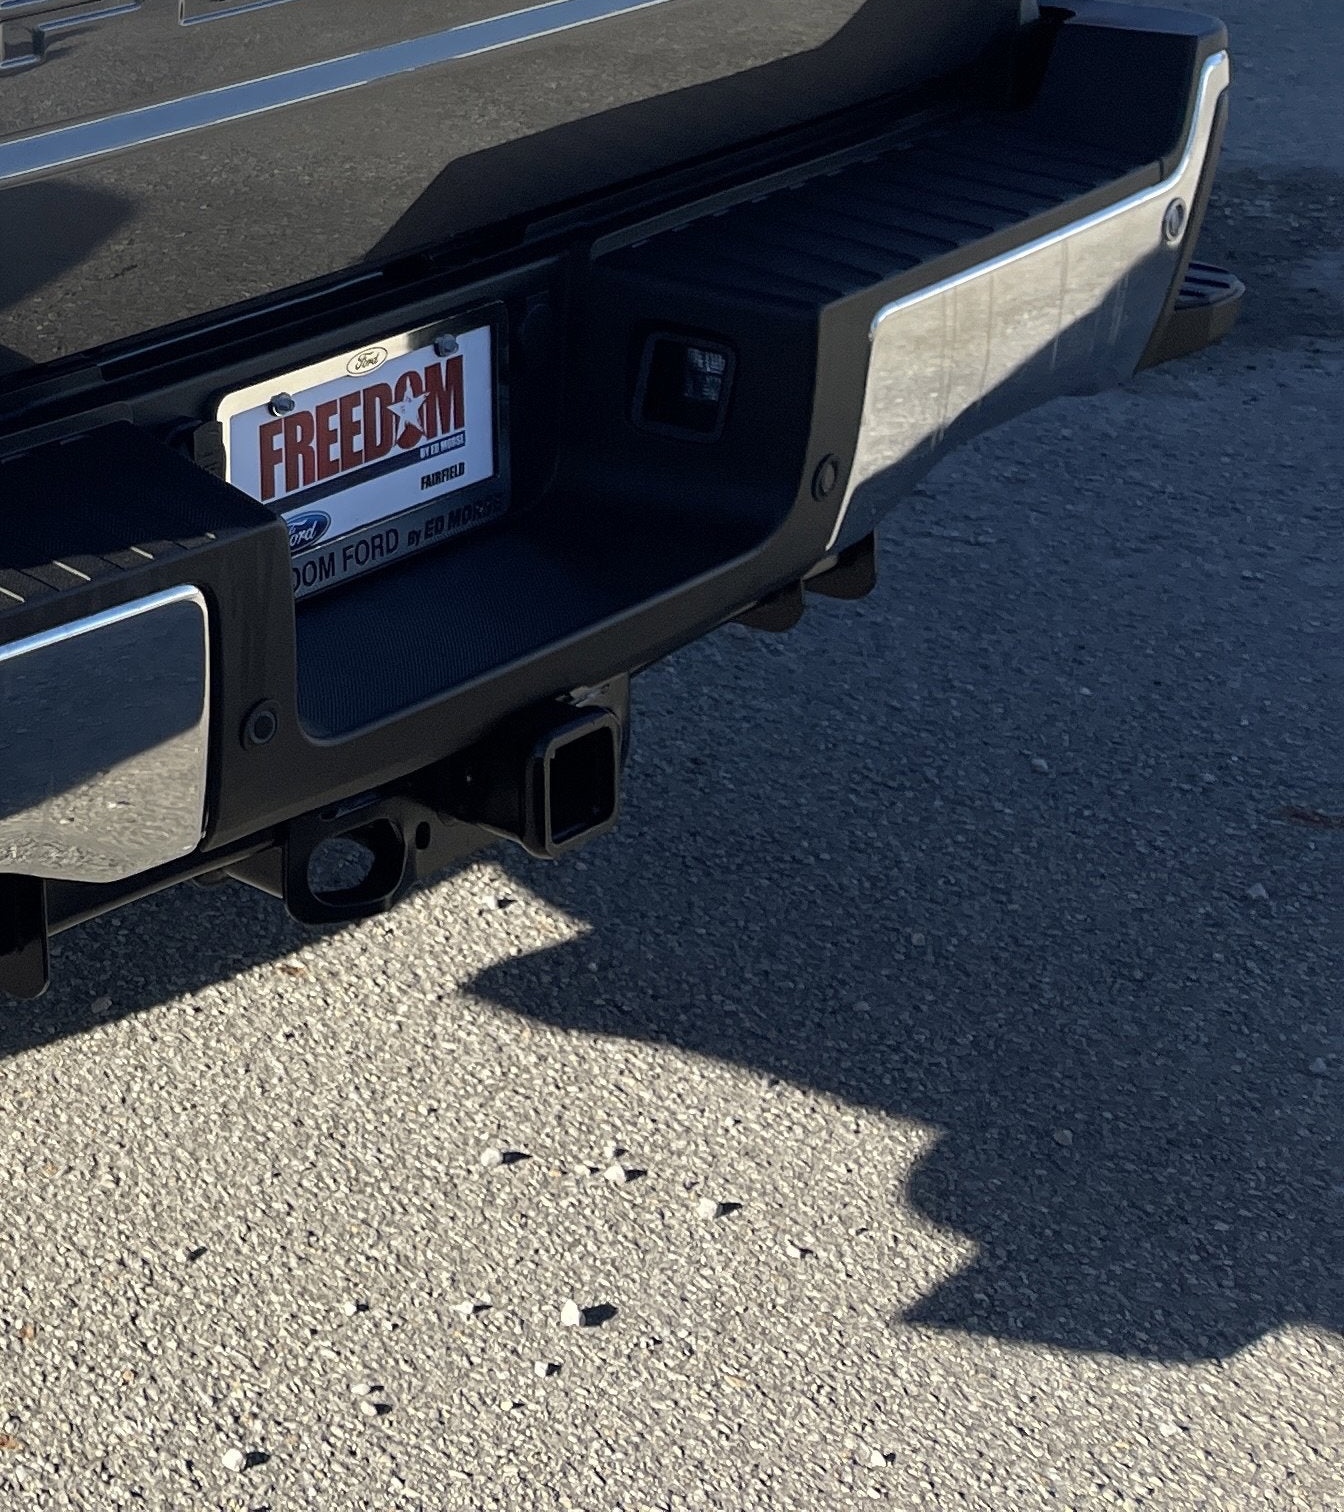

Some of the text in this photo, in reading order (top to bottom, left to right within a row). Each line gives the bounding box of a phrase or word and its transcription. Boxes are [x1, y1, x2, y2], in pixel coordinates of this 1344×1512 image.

[354, 348, 380, 371] Ford
[259, 355, 465, 502] FREEDOM
[420, 462, 465, 490] FAIRFIELD
[342, 528, 399, 572] FORD
[424, 514, 445, 540] ED
